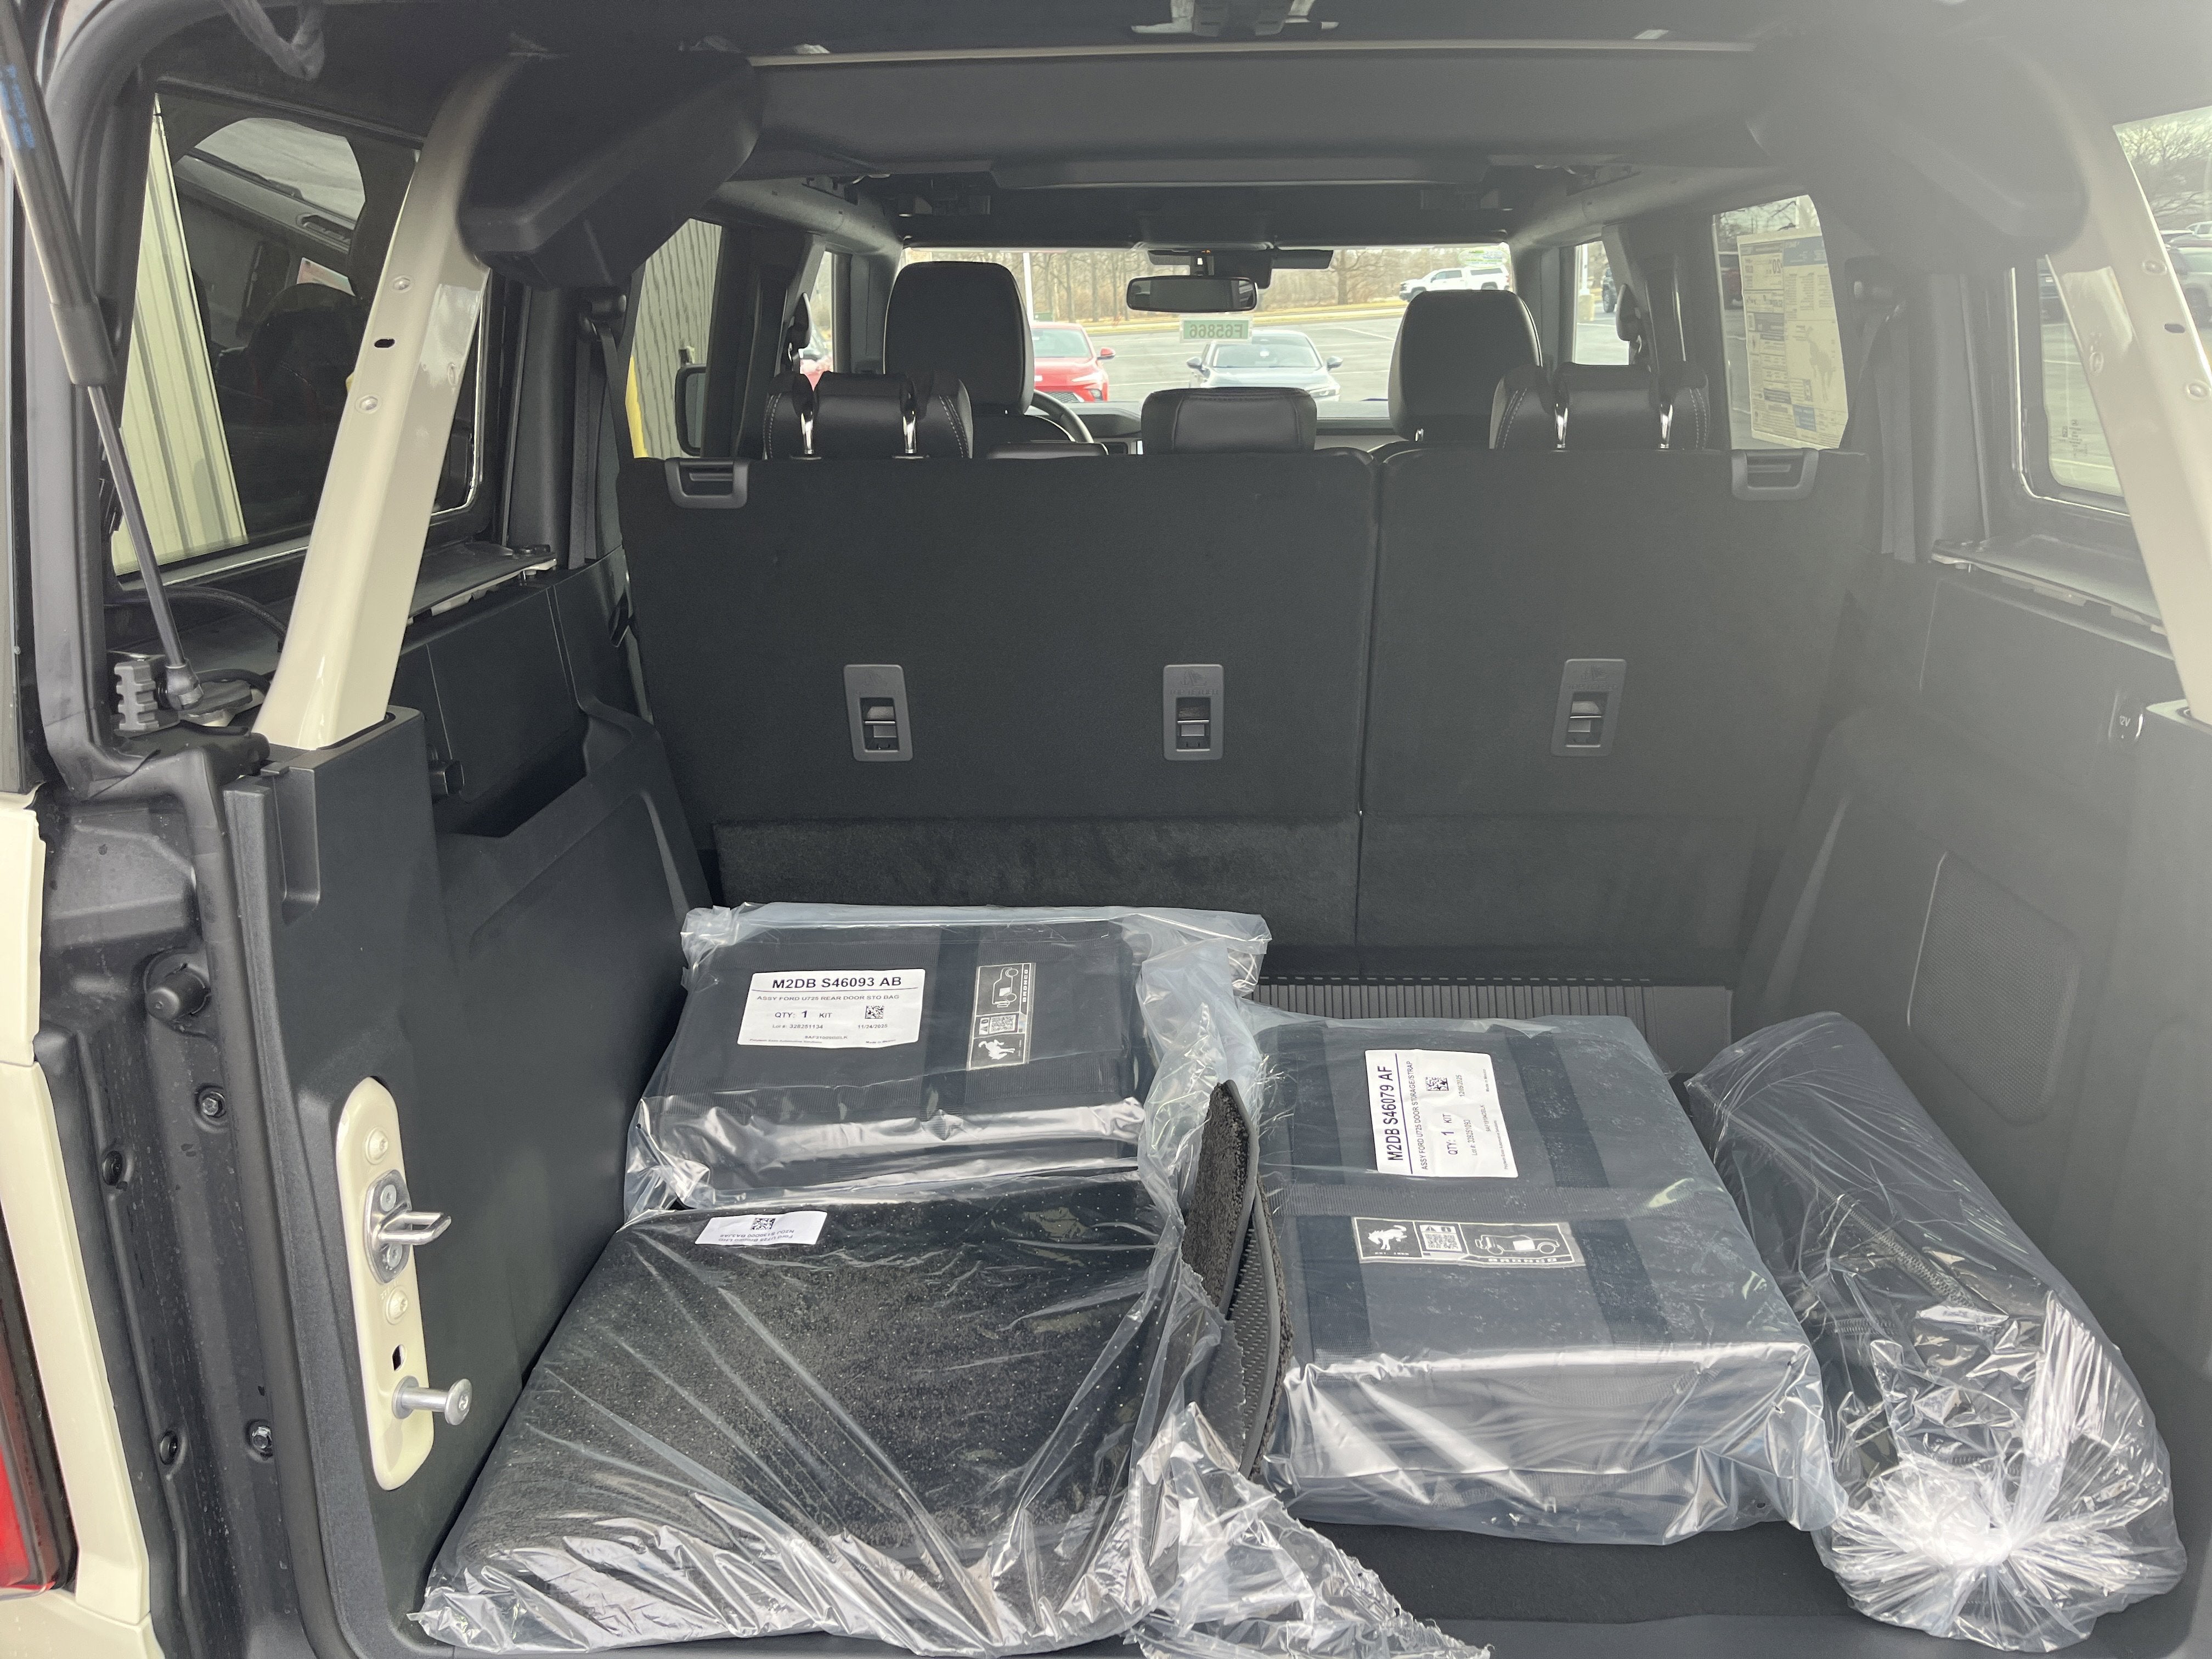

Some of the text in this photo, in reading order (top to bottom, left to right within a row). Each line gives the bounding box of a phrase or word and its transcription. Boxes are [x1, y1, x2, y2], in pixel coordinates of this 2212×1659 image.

[772, 976, 902, 989] M2DB S46093 AB
[1377, 1065, 1403, 1161] M2DB S46079 AF
[1406, 1060, 1429, 1170] ASSY FORD U725 DOOR STORAGE/STRAP
[1442, 1114, 1453, 1124] KIT
[1446, 1139, 1458, 1155] QTY:
